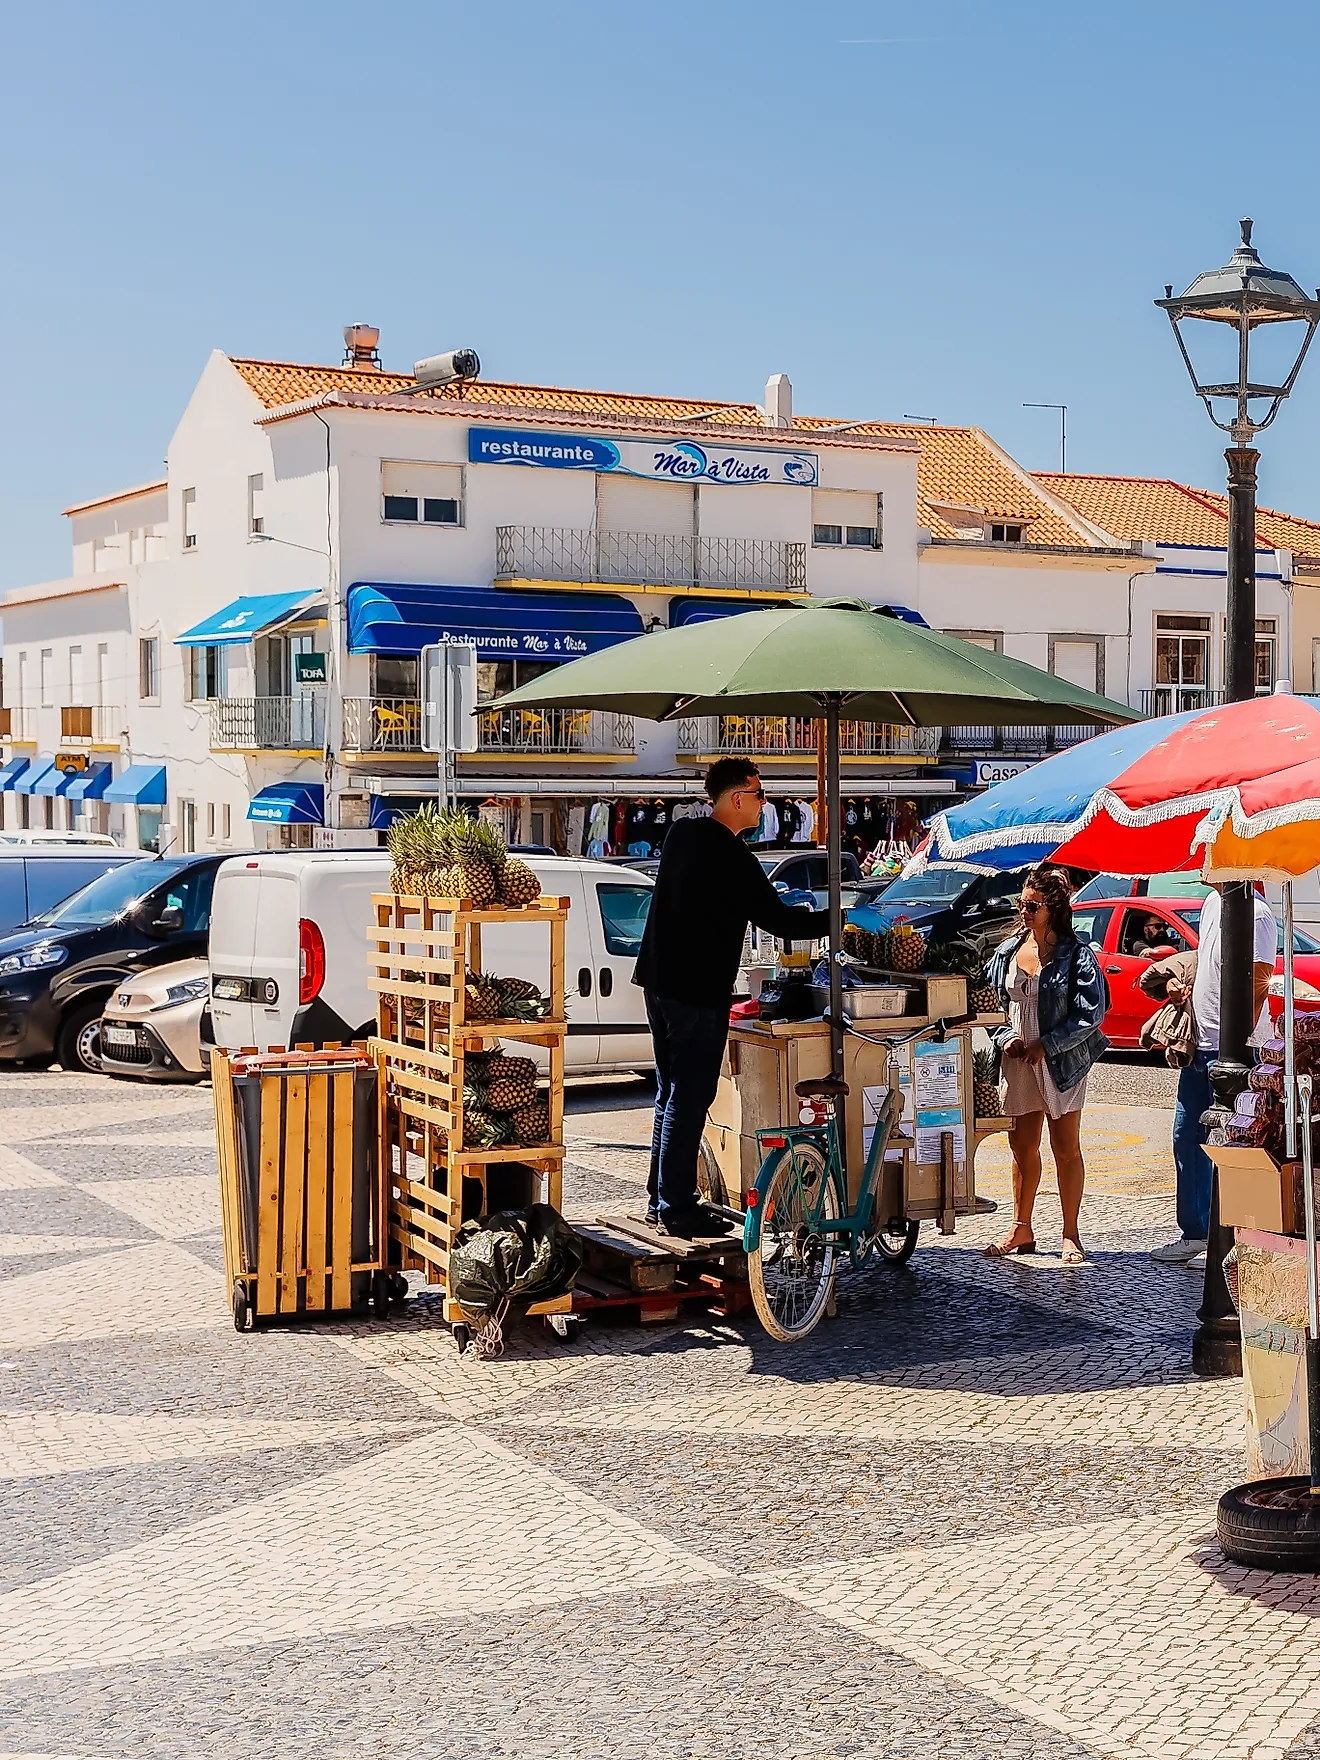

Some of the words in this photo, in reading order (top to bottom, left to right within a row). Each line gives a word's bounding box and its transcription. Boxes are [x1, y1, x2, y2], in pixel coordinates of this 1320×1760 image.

[481, 439, 595, 462] restaurante
[653, 452, 700, 477] Mar
[708, 460, 720, 477] à
[721, 457, 771, 481] Vista
[442, 631, 519, 649] Restaurante
[523, 635, 550, 652] Mar
[554, 638, 561, 650] à
[563, 635, 588, 651] Vista
[300, 668, 325, 679] TOFA
[979, 763, 1019, 781] Casa
